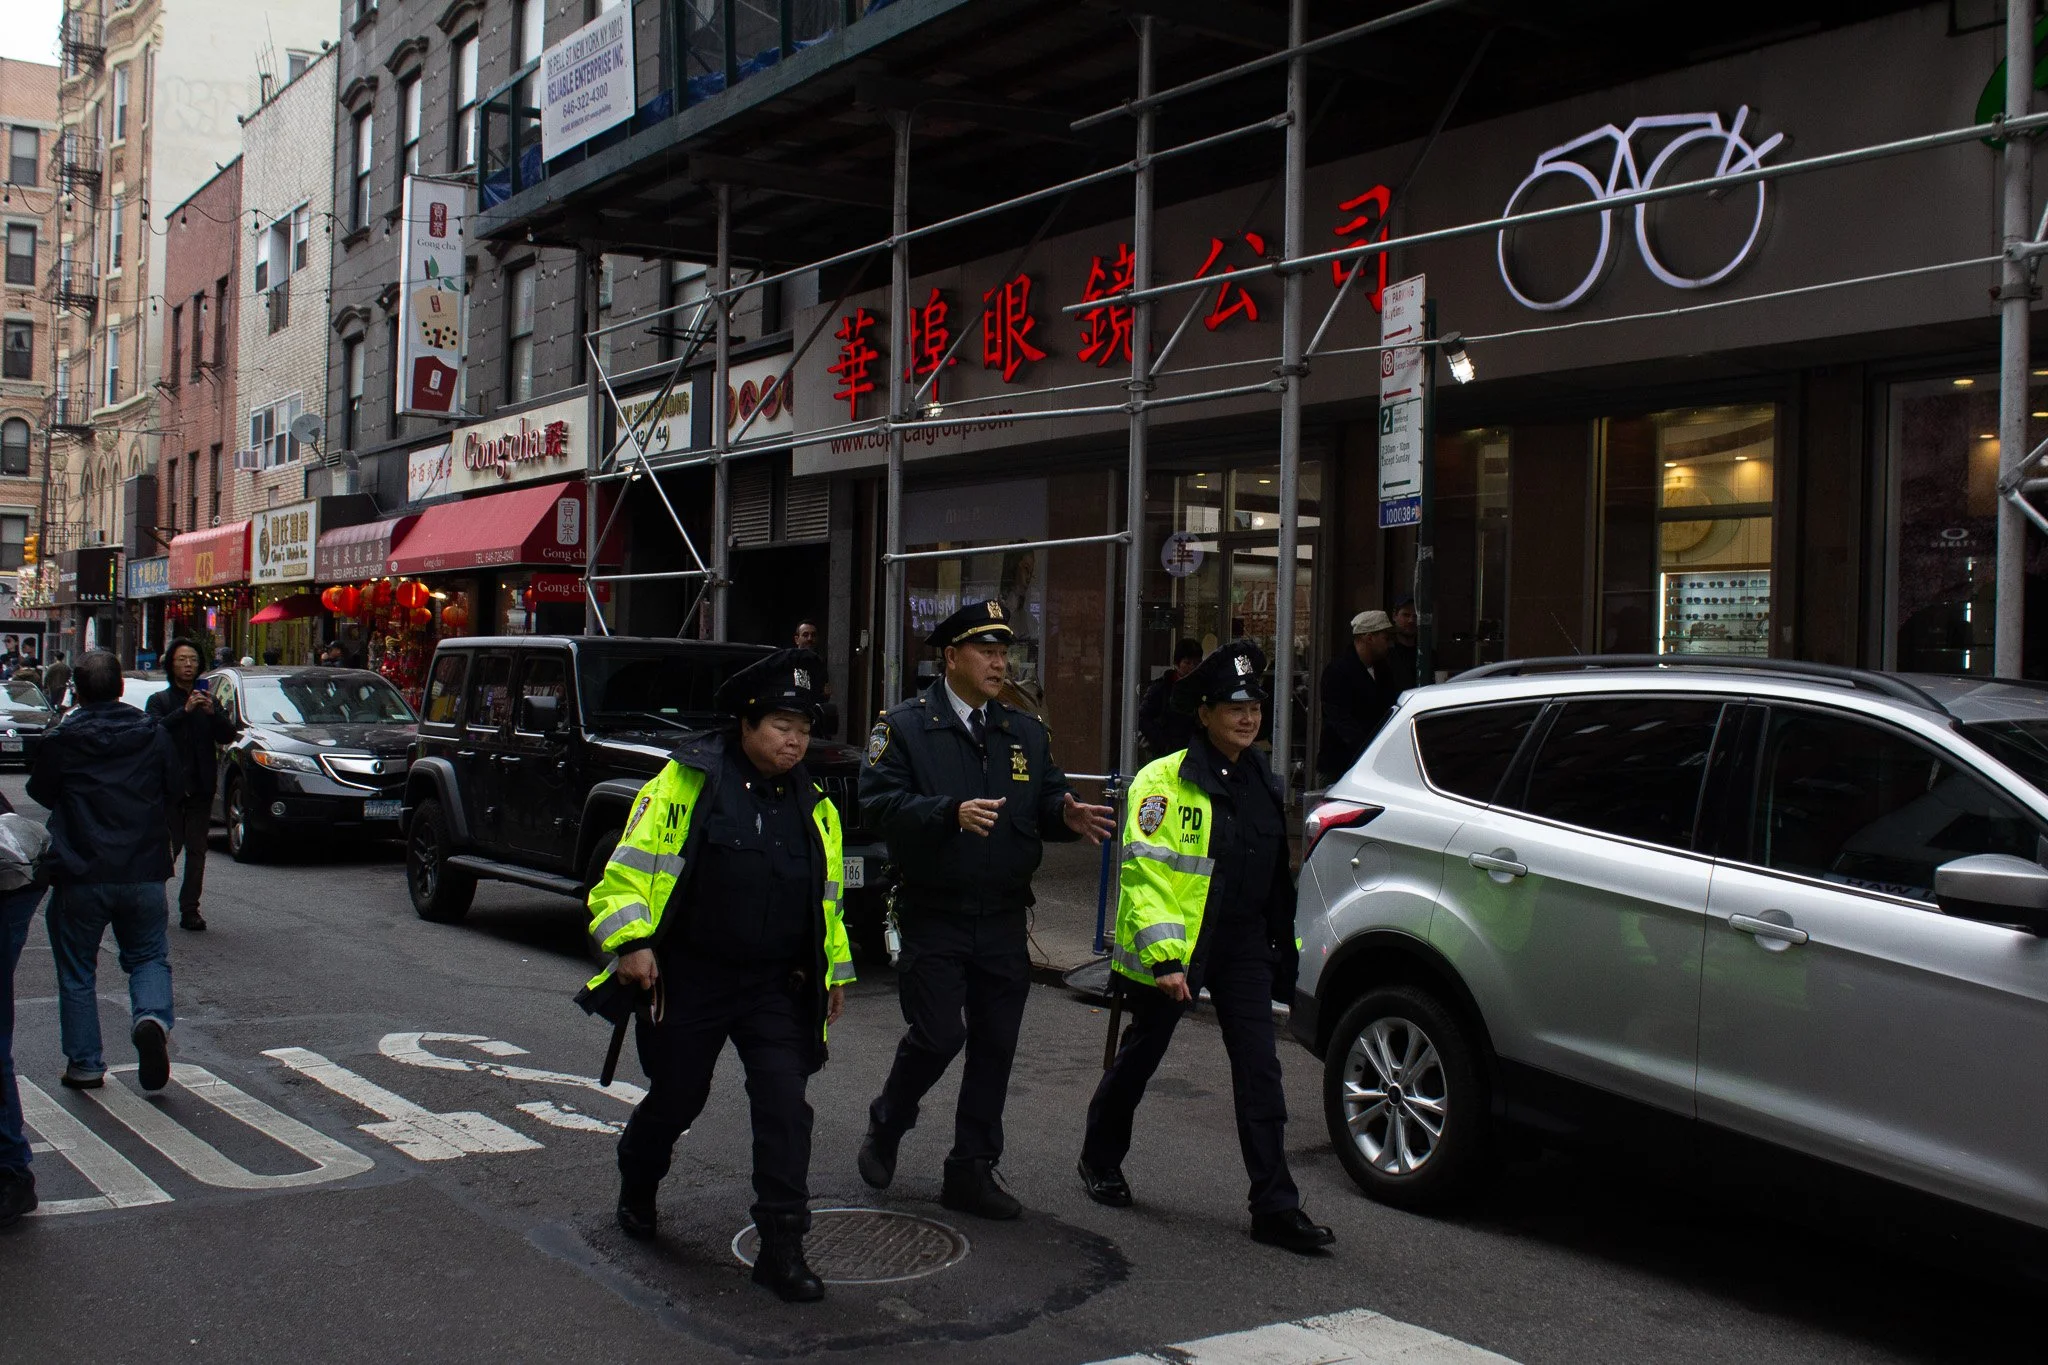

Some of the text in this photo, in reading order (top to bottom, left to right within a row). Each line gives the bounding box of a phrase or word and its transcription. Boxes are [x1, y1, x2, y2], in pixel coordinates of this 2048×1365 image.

[573, 42, 585, 60] NEW
[585, 31, 599, 53] YORK
[548, 44, 624, 105] RELIABLE ENTERPRISE INC
[417, 238, 456, 251] Gong cha
[1383, 409, 1390, 433] 2
[656, 425, 667, 443] 44
[830, 408, 1014, 455] www.copcalgroup.com
[463, 432, 506, 479] Gong
[509, 418, 542, 462] cha
[543, 548, 571, 562] Gong
[343, 566, 358, 578] APPLE
[358, 565, 369, 576] GIFT
[369, 563, 383, 576] SHOP
[538, 581, 570, 596] Gong
[1180, 833, 1201, 844] IARY
